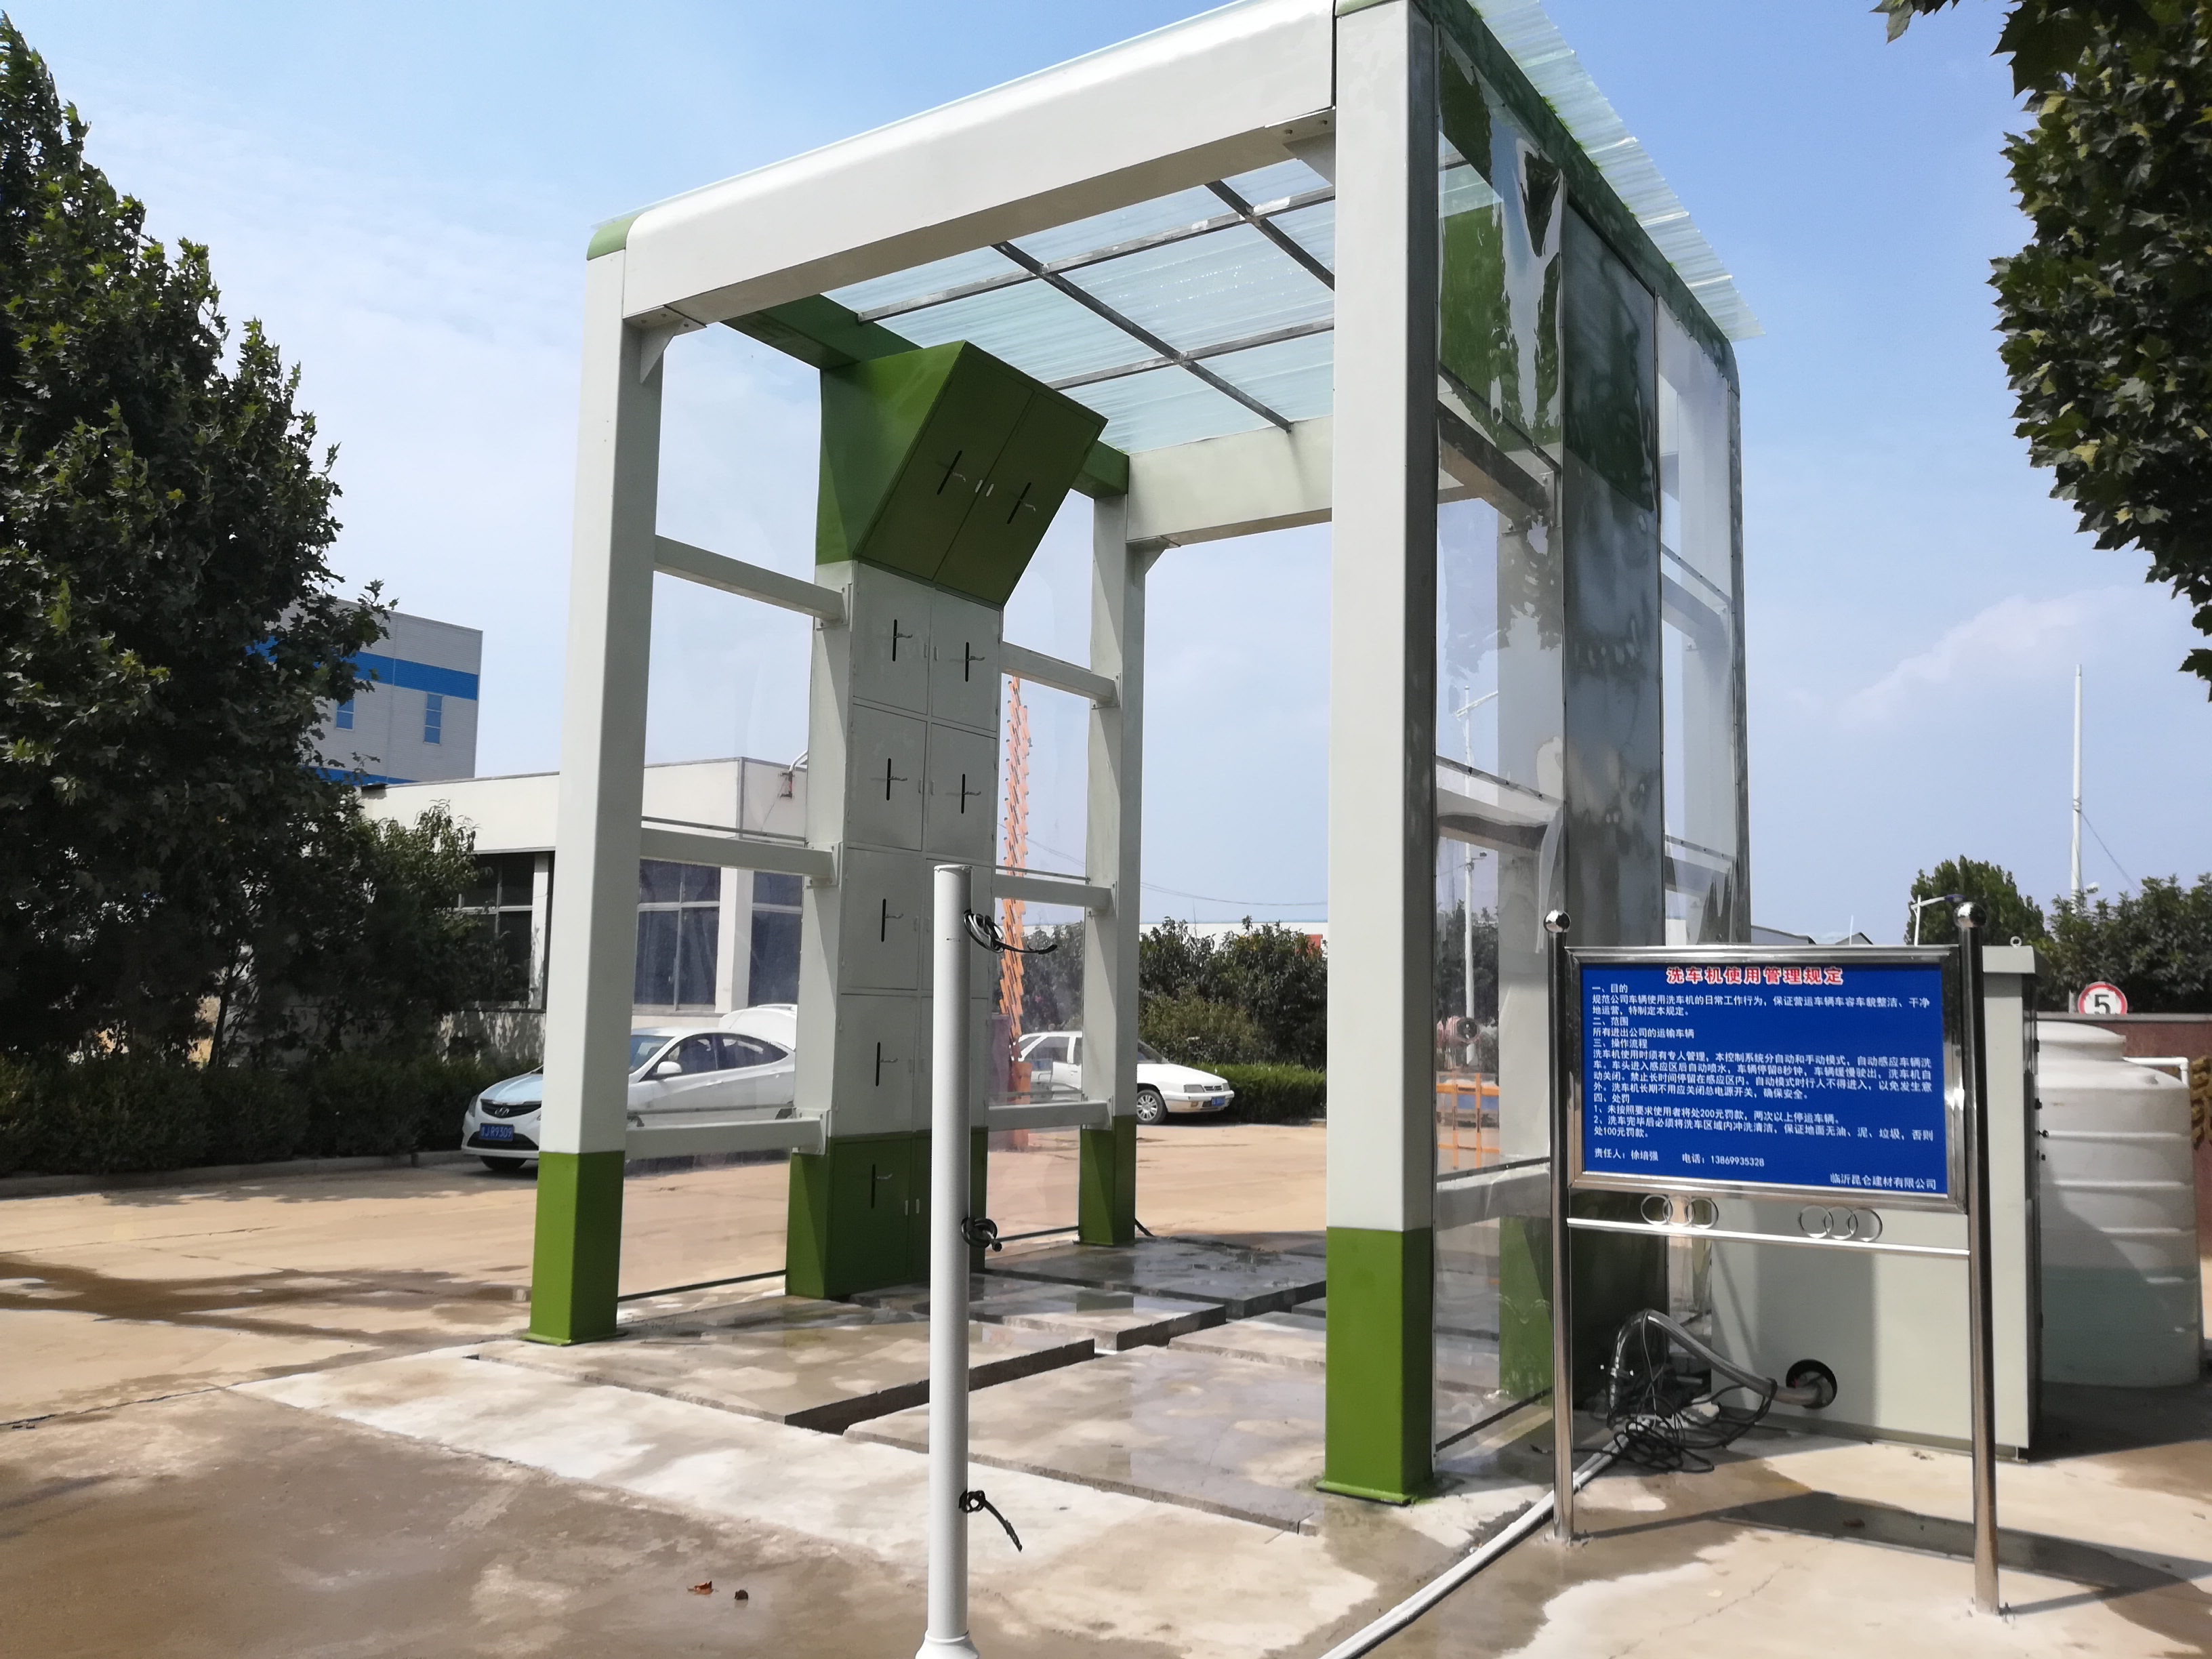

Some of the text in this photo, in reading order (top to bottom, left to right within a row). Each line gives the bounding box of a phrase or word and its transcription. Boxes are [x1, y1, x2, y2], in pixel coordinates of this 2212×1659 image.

[1666, 966, 1843, 985] 洗车机使用管理规定
[1591, 983, 1628, 994] 一、目的
[2095, 994, 2111, 1014] 5
[1592, 1016, 1629, 1026] 二、范围
[1592, 1027, 1694, 1039] 所有进出公司的运输车辆
[1593, 1038, 1647, 1049] 三、操作流程
[1593, 1092, 1629, 1104] 四、处罚
[1593, 1126, 1648, 1139] 处100元罚款。
[1830, 1172, 1936, 1190] 临沂昆仑建材有限公司
